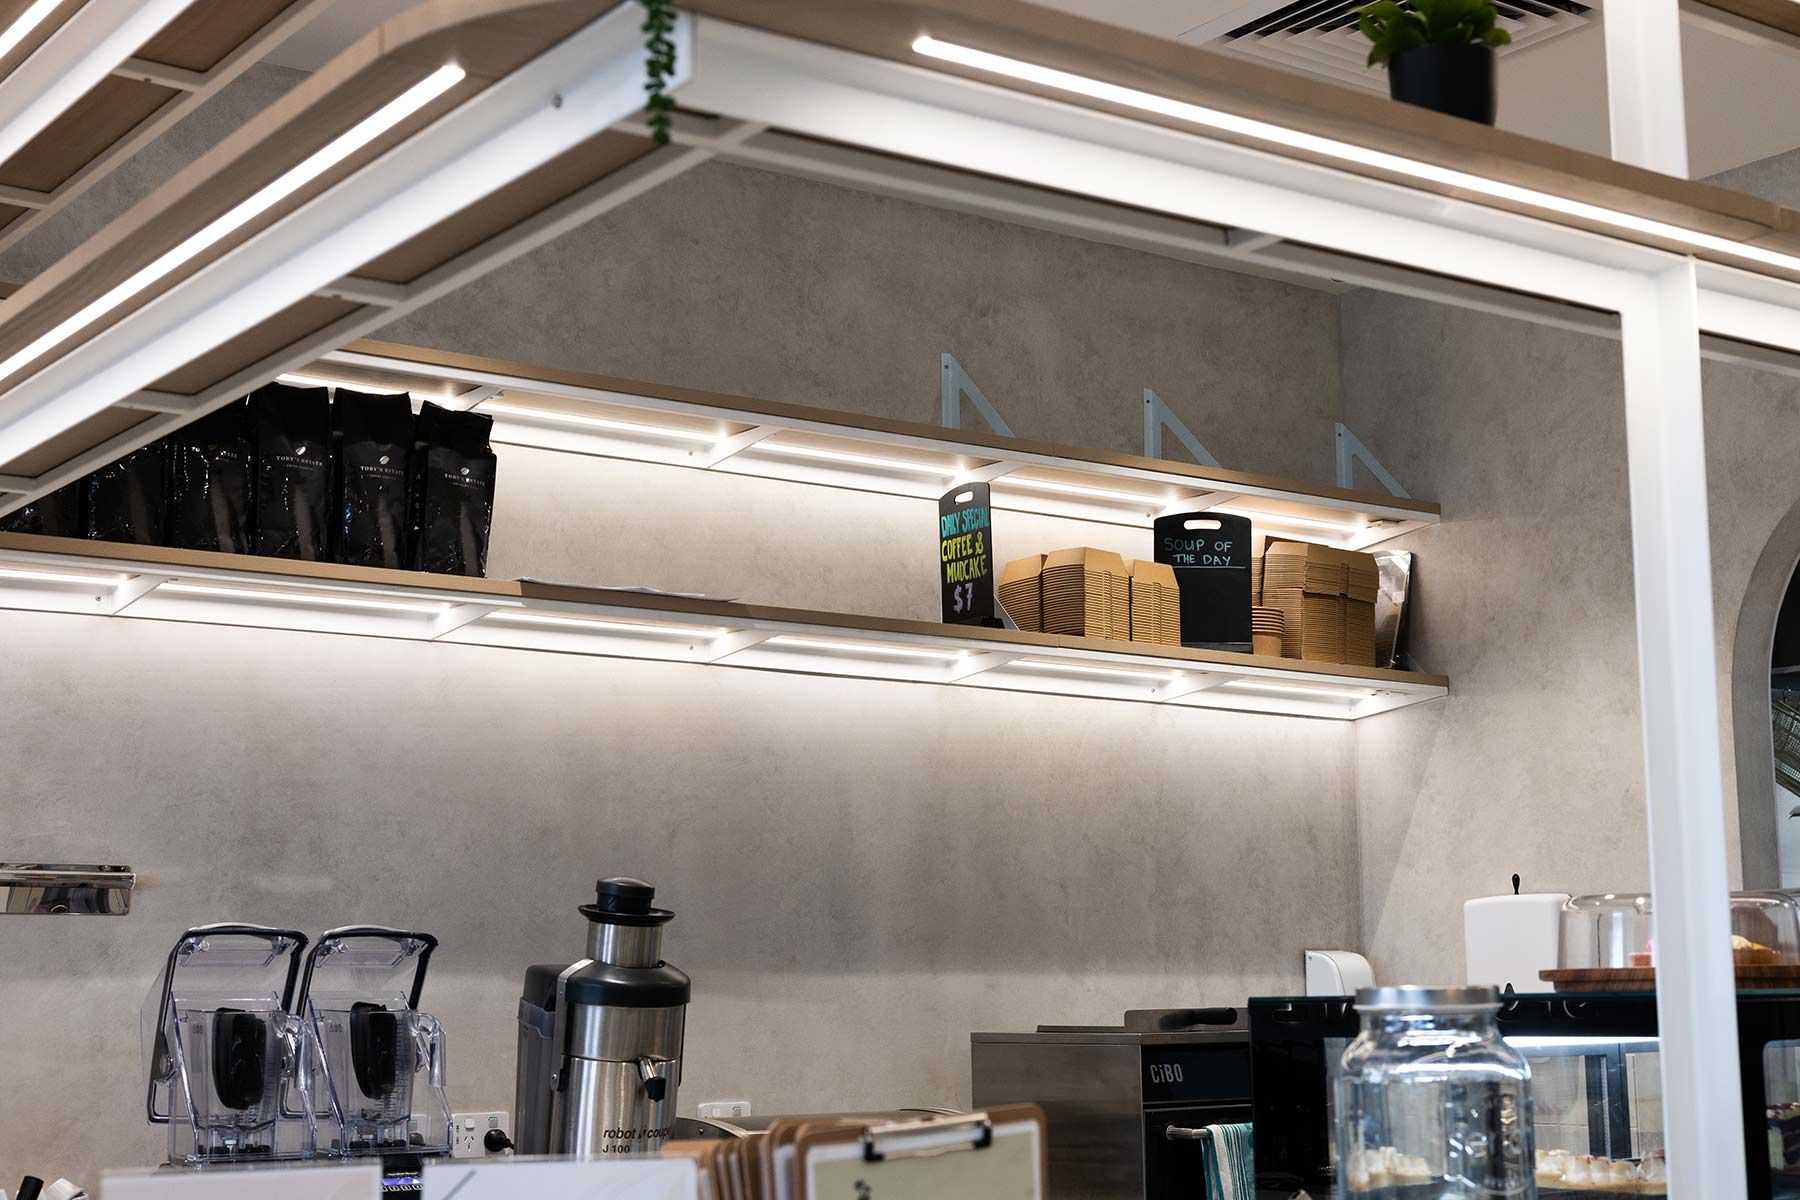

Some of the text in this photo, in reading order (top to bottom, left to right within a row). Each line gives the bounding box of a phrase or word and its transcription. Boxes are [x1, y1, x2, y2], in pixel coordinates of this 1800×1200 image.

[940, 506, 990, 538] DAILY SPECIAL
[941, 531, 984, 562] COFFEE &
[1163, 537, 1233, 552] SOUP OF
[1172, 553, 1231, 566] THE DAY
[946, 553, 988, 584] MUDCAKE
[603, 1127, 636, 1139] robot
[602, 1144, 630, 1154] J 100
